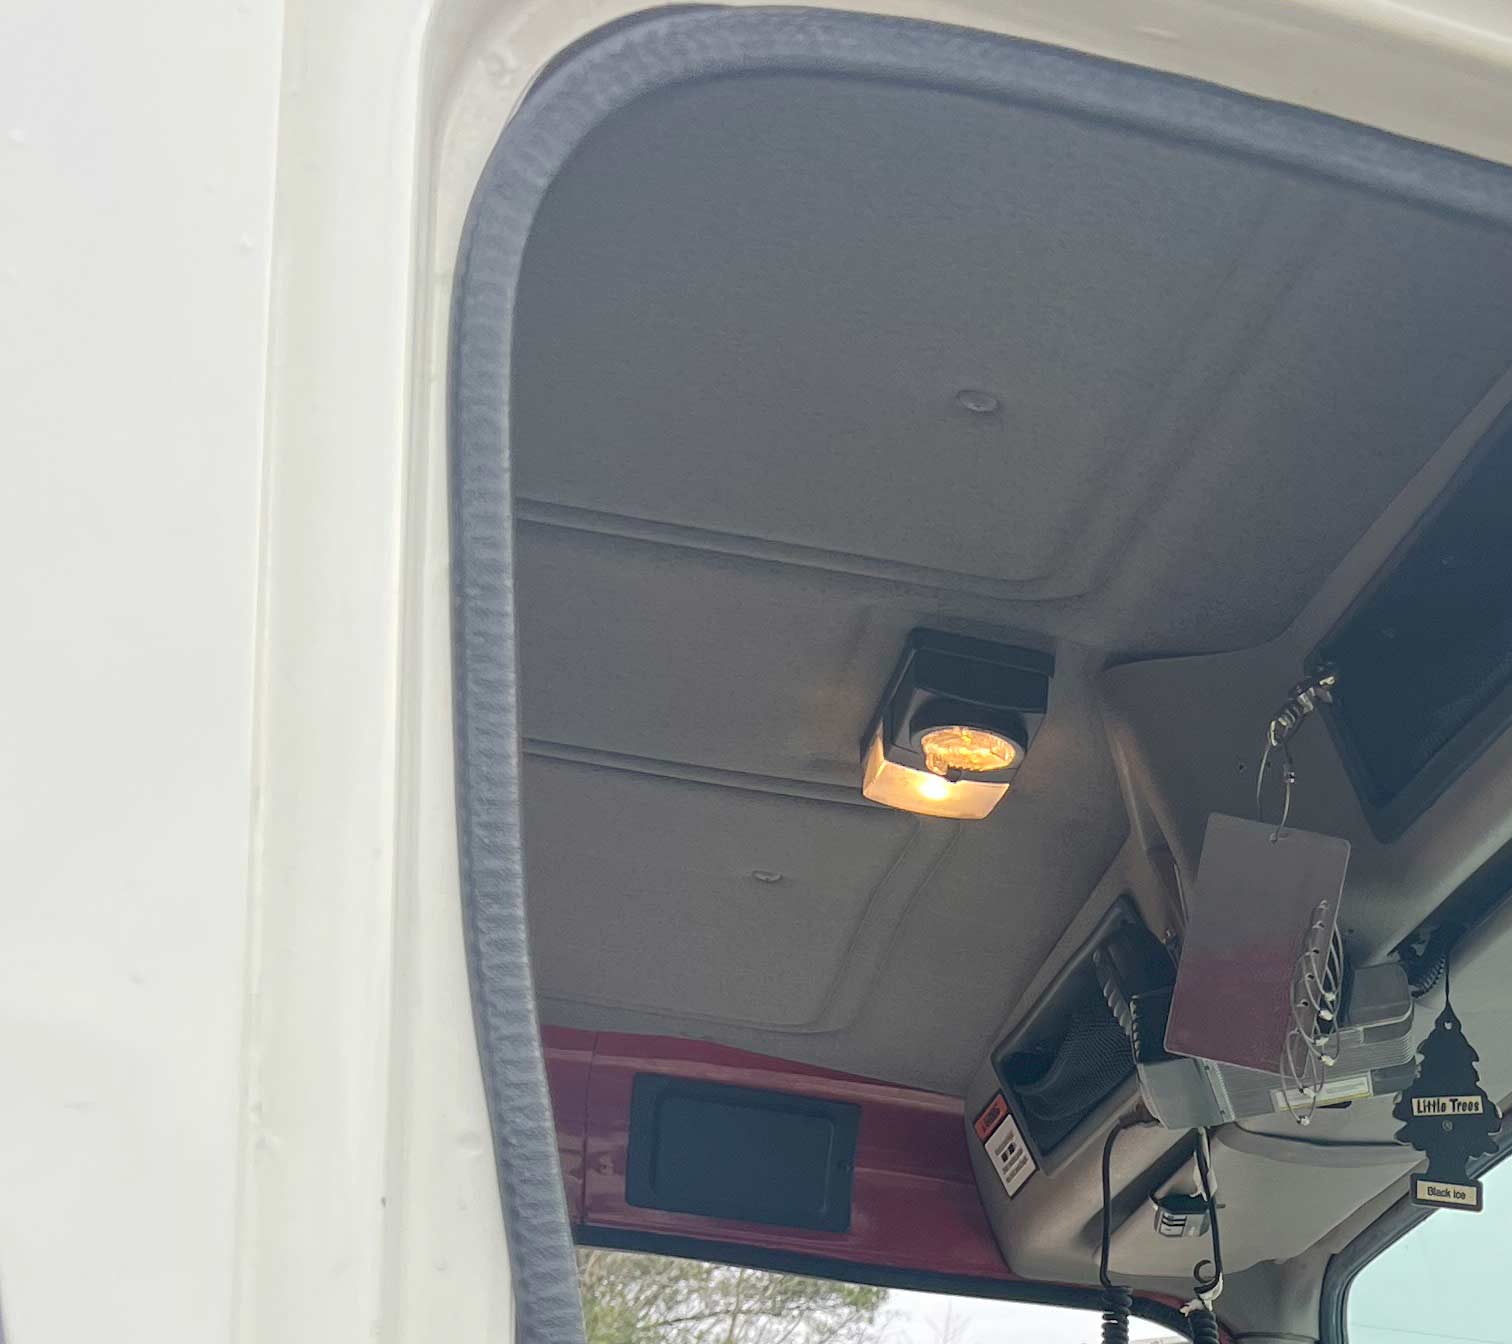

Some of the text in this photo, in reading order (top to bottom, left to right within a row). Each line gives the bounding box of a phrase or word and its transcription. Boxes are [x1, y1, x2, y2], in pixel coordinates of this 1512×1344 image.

[1417, 1097, 1480, 1114] Little Trees
[1427, 1186, 1467, 1200] Black Ice
